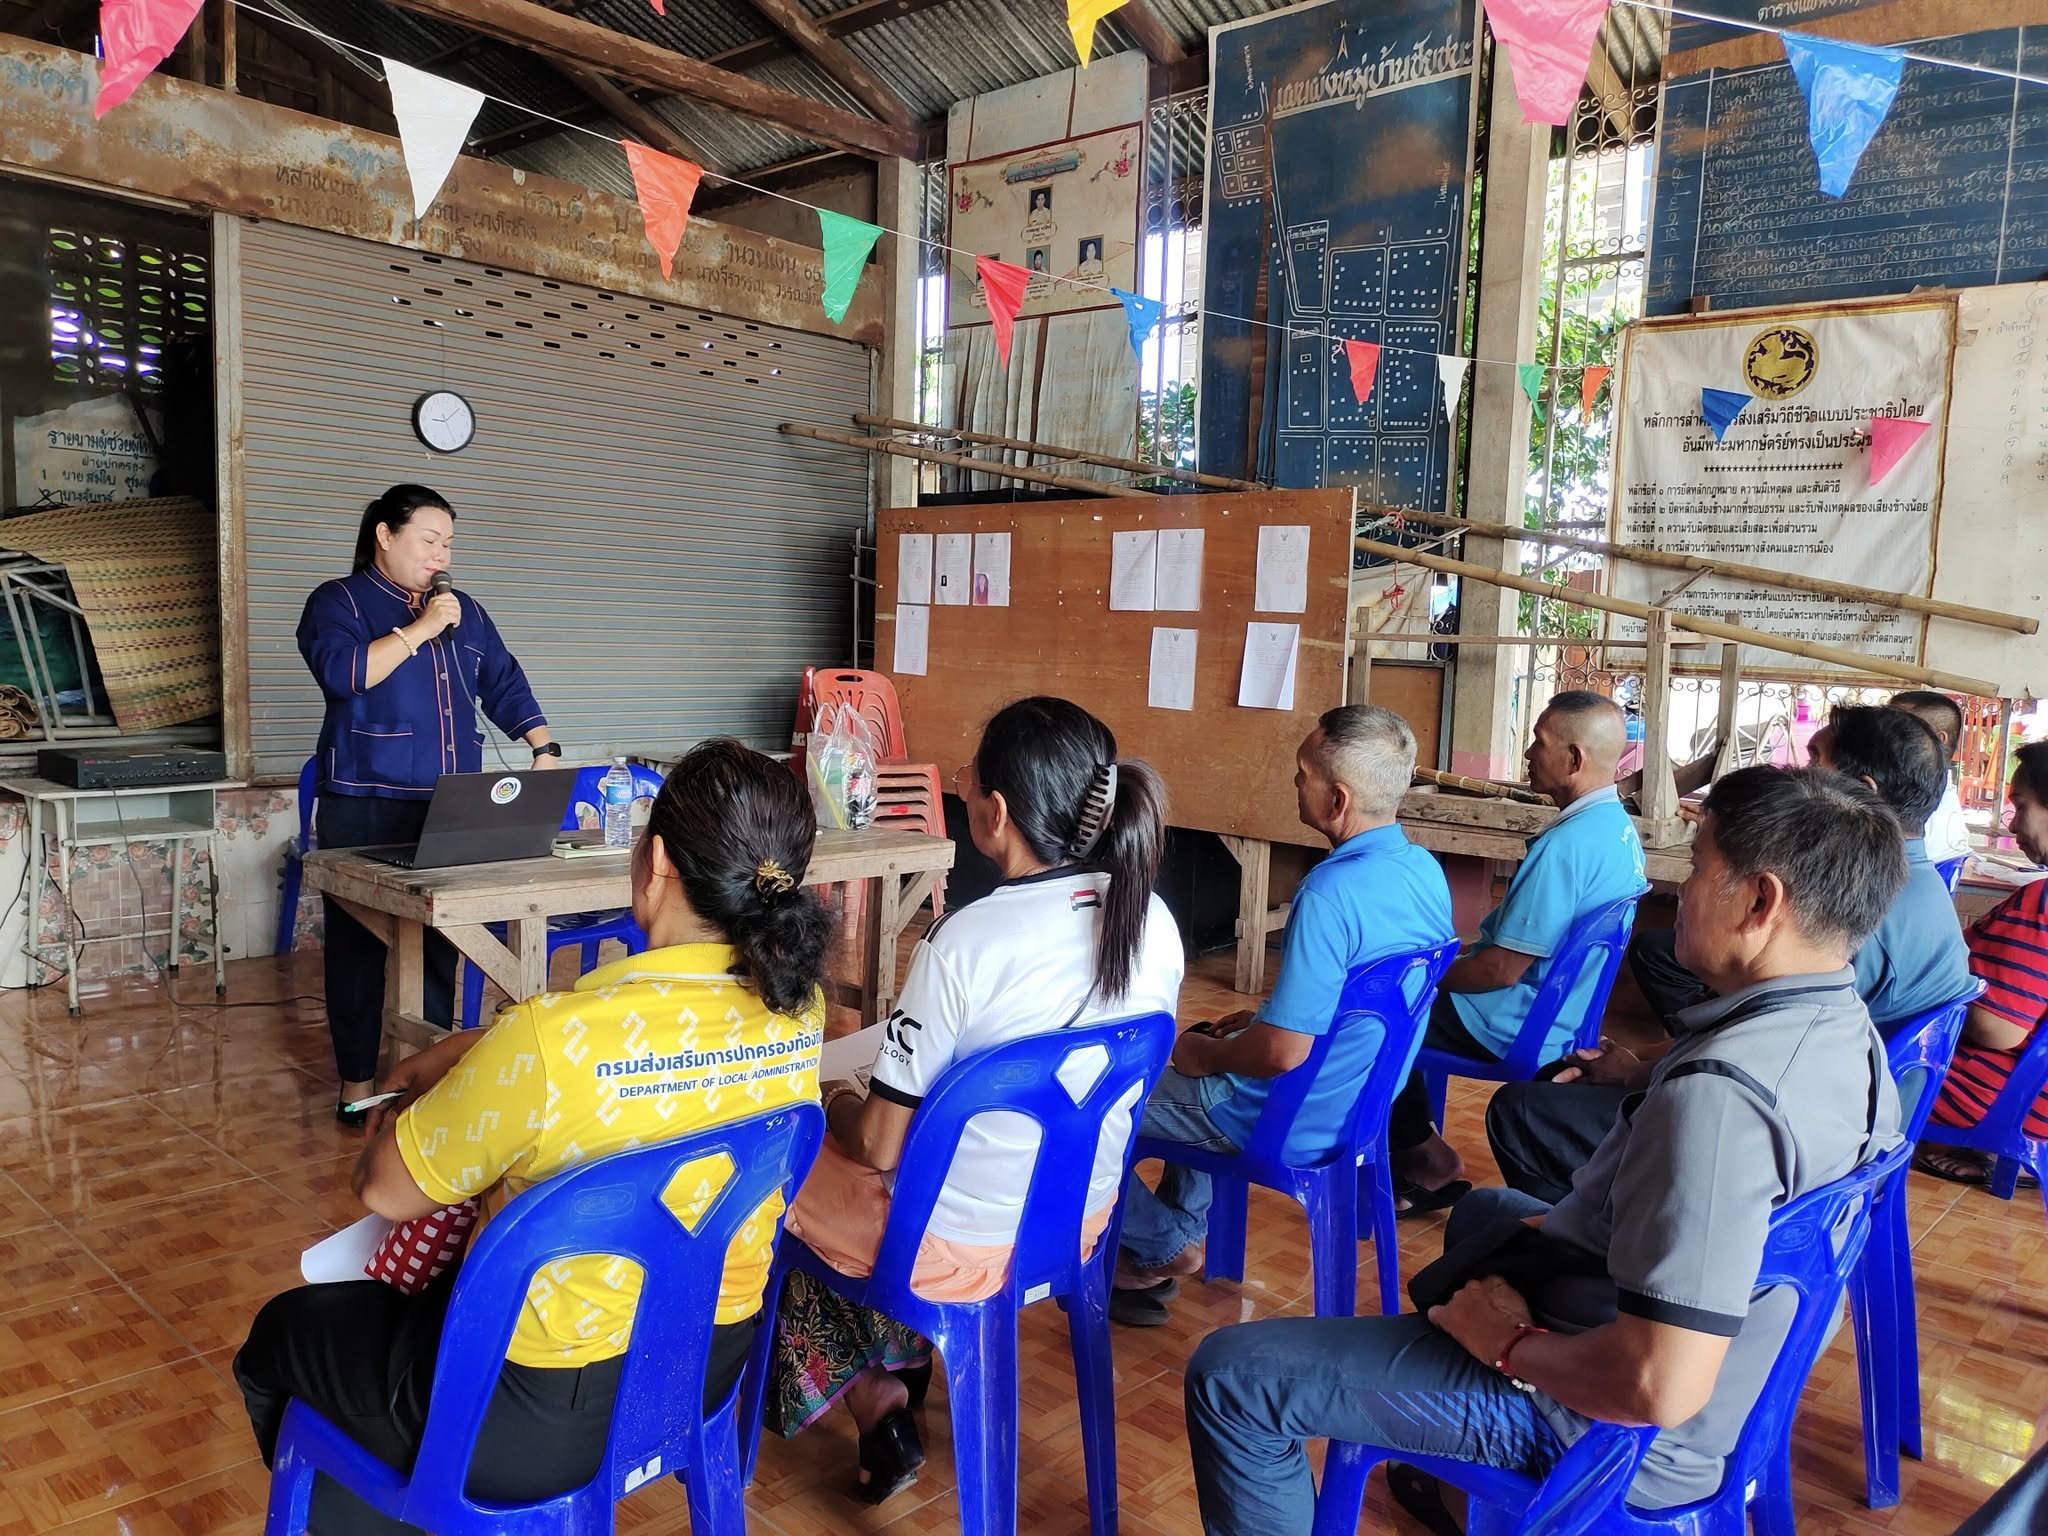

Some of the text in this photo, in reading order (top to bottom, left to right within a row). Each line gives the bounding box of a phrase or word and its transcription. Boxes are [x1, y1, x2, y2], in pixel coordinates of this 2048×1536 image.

[619, 1079, 698, 1098] DEPARTMENT
[701, 1076, 716, 1089] OF
[718, 1072, 750, 1086] LOCAL
